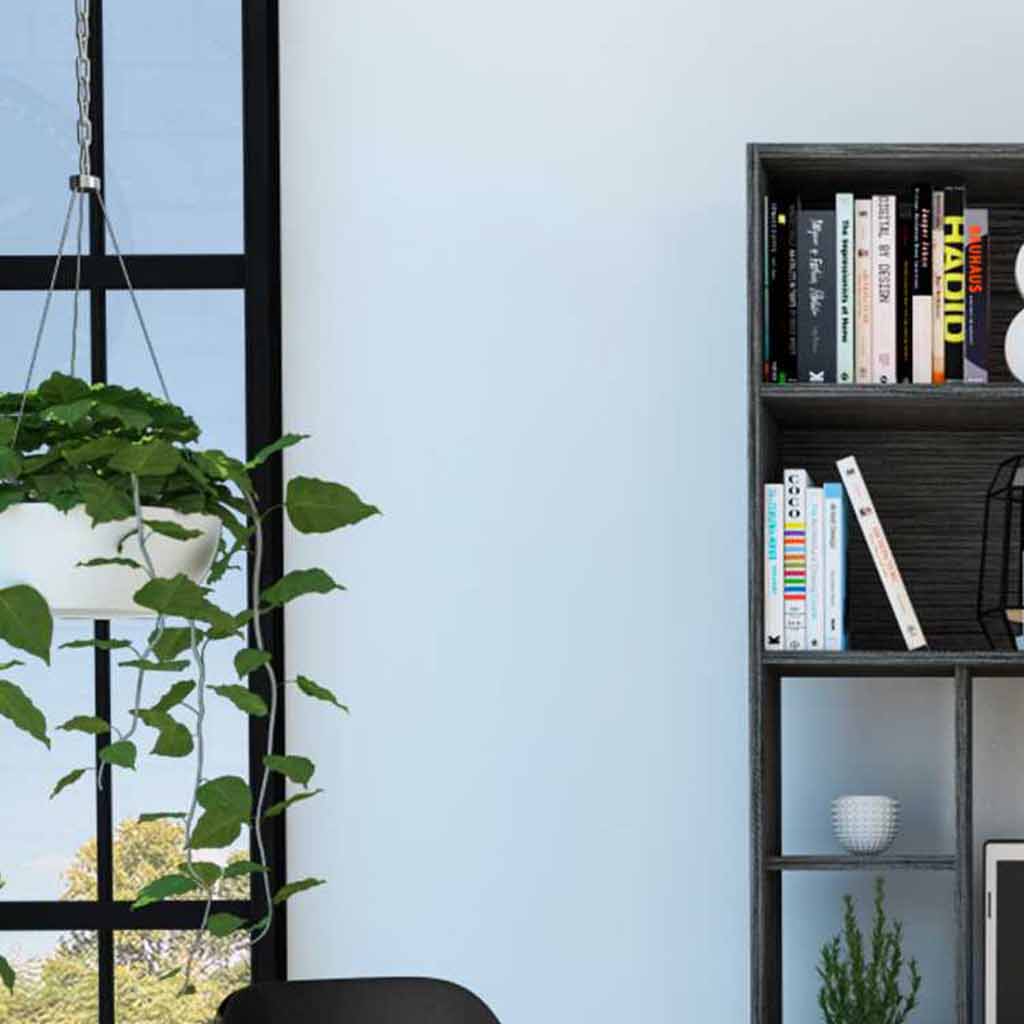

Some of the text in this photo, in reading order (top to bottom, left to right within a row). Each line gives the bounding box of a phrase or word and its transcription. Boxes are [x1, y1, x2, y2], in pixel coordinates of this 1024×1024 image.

[842, 219, 850, 236] The
[878, 196, 891, 304] DIGITAL BY DESIGN
[968, 225, 983, 293] BAUHAUS
[944, 215, 966, 344] HADID
